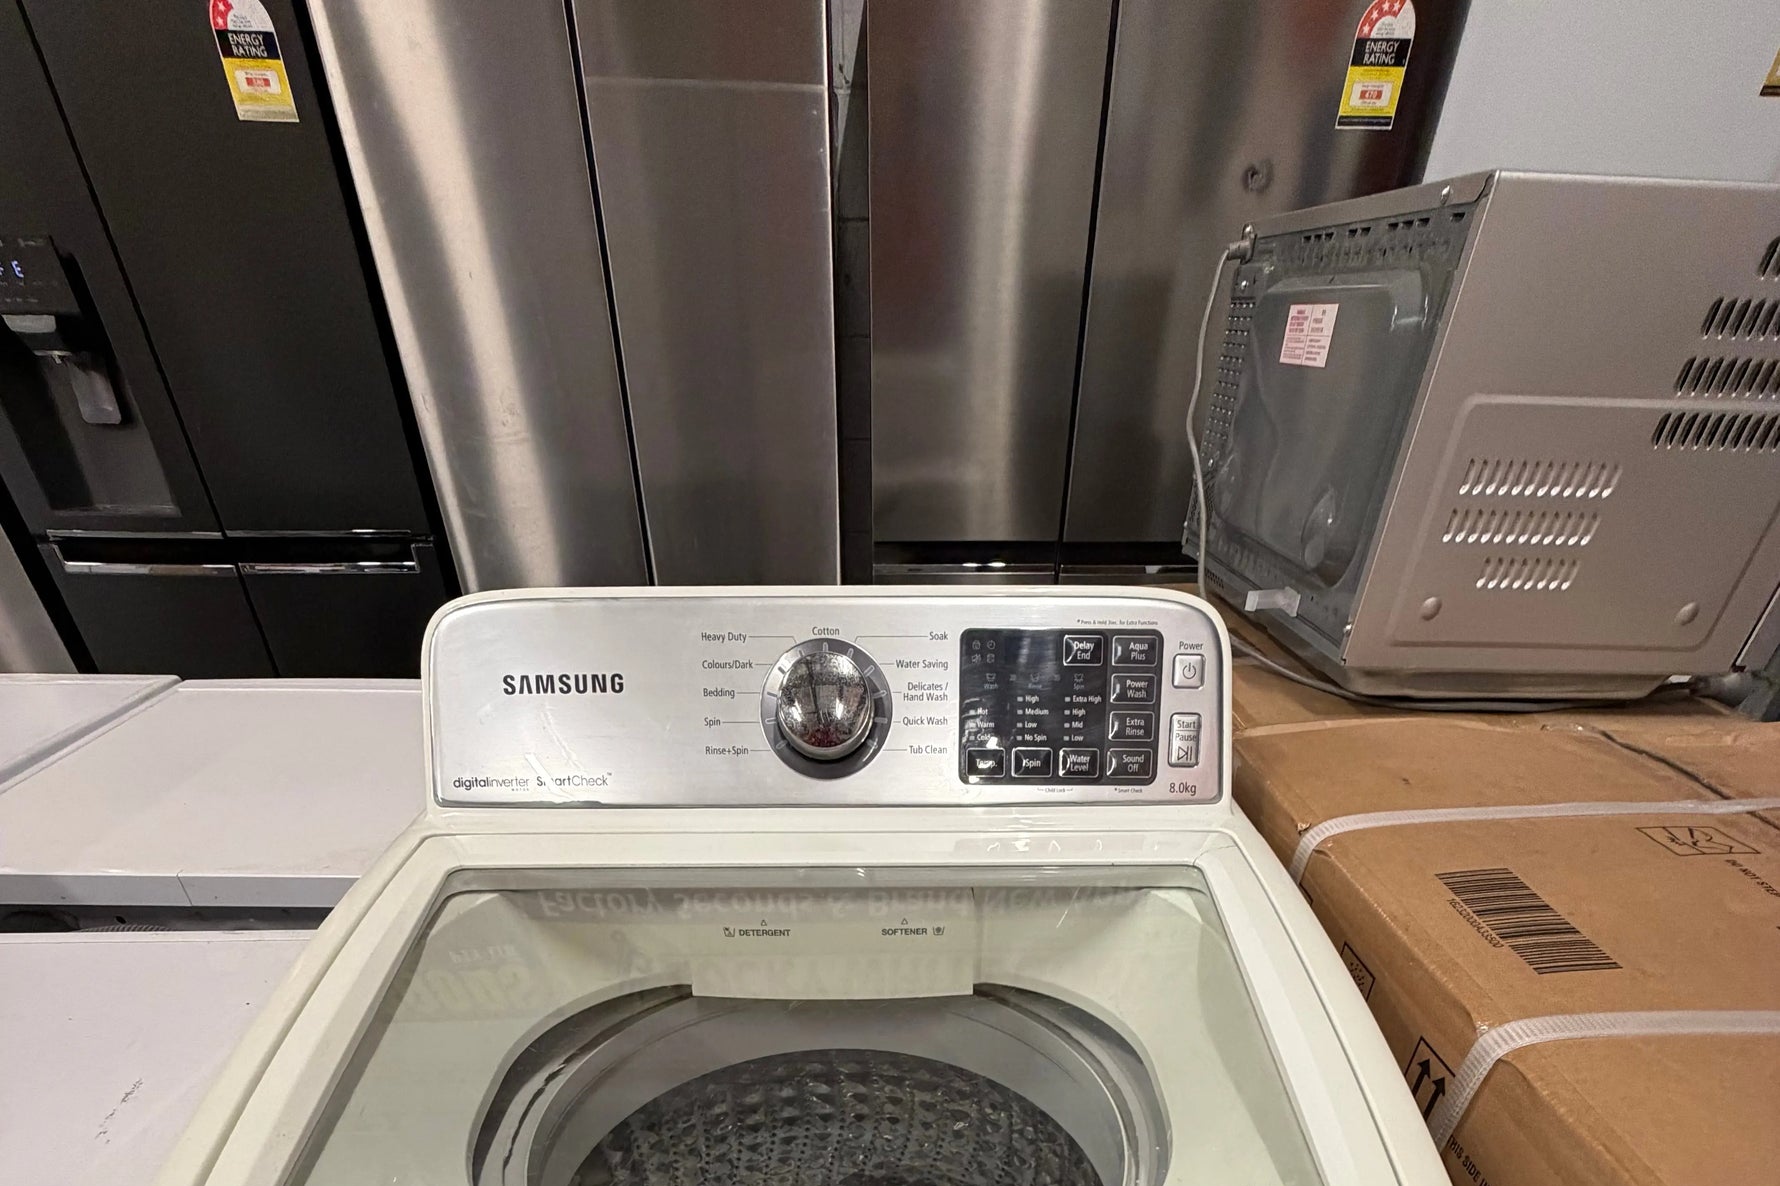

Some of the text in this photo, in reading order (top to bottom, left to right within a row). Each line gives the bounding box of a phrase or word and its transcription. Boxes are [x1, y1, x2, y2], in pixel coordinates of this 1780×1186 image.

[228, 33, 263, 46] ENERGY
[231, 45, 268, 58] RATING
[1365, 41, 1400, 53] ENERGY
[1363, 52, 1396, 65] RATING
[812, 626, 840, 636] Cotton
[929, 631, 948, 641] Soak
[701, 632, 747, 643] Heavy Duty
[1074, 641, 1095, 652] Delay
[1129, 642, 1149, 652] Aqua
[1179, 641, 1203, 650] Power
[1077, 651, 1091, 660] End
[1131, 651, 1146, 660] Plus
[702, 660, 753, 670] Colours/Dark
[895, 659, 949, 671] Water Saving
[502, 673, 625, 695] SAMSUNG
[907, 682, 942, 692] Delicates
[1126, 680, 1149, 689] Power
[703, 688, 735, 699] Bedding
[903, 692, 948, 702] Hand Wash
[1127, 689, 1147, 698] Wash
[1025, 695, 1040, 704] High
[1072, 695, 1102, 704] Extra High
[1072, 708, 1086, 717] High
[704, 717, 721, 728] Spin
[902, 717, 948, 727] Quick Wash
[1126, 718, 1145, 727] Extra
[1177, 720, 1197, 729] Start
[1125, 727, 1145, 736] Rinse
[1025, 734, 1047, 742] No Spin
[1071, 734, 1084, 742] Low
[1175, 733, 1197, 742] Pause
[705, 745, 749, 756] Rinse+Spin
[909, 745, 948, 755] Tub Clean
[1025, 758, 1041, 768] Spin
[1070, 754, 1091, 763] Water
[1122, 754, 1144, 763] Sound
[1070, 763, 1089, 772] Level
[1127, 763, 1139, 772] Off
[1169, 783, 1197, 796] 8.0kg
[738, 928, 791, 937] DETERGENT
[881, 928, 928, 936] SOFTENER
[1447, 1134, 1464, 1159] THIS
[1462, 1155, 1481, 1182] SIDE
